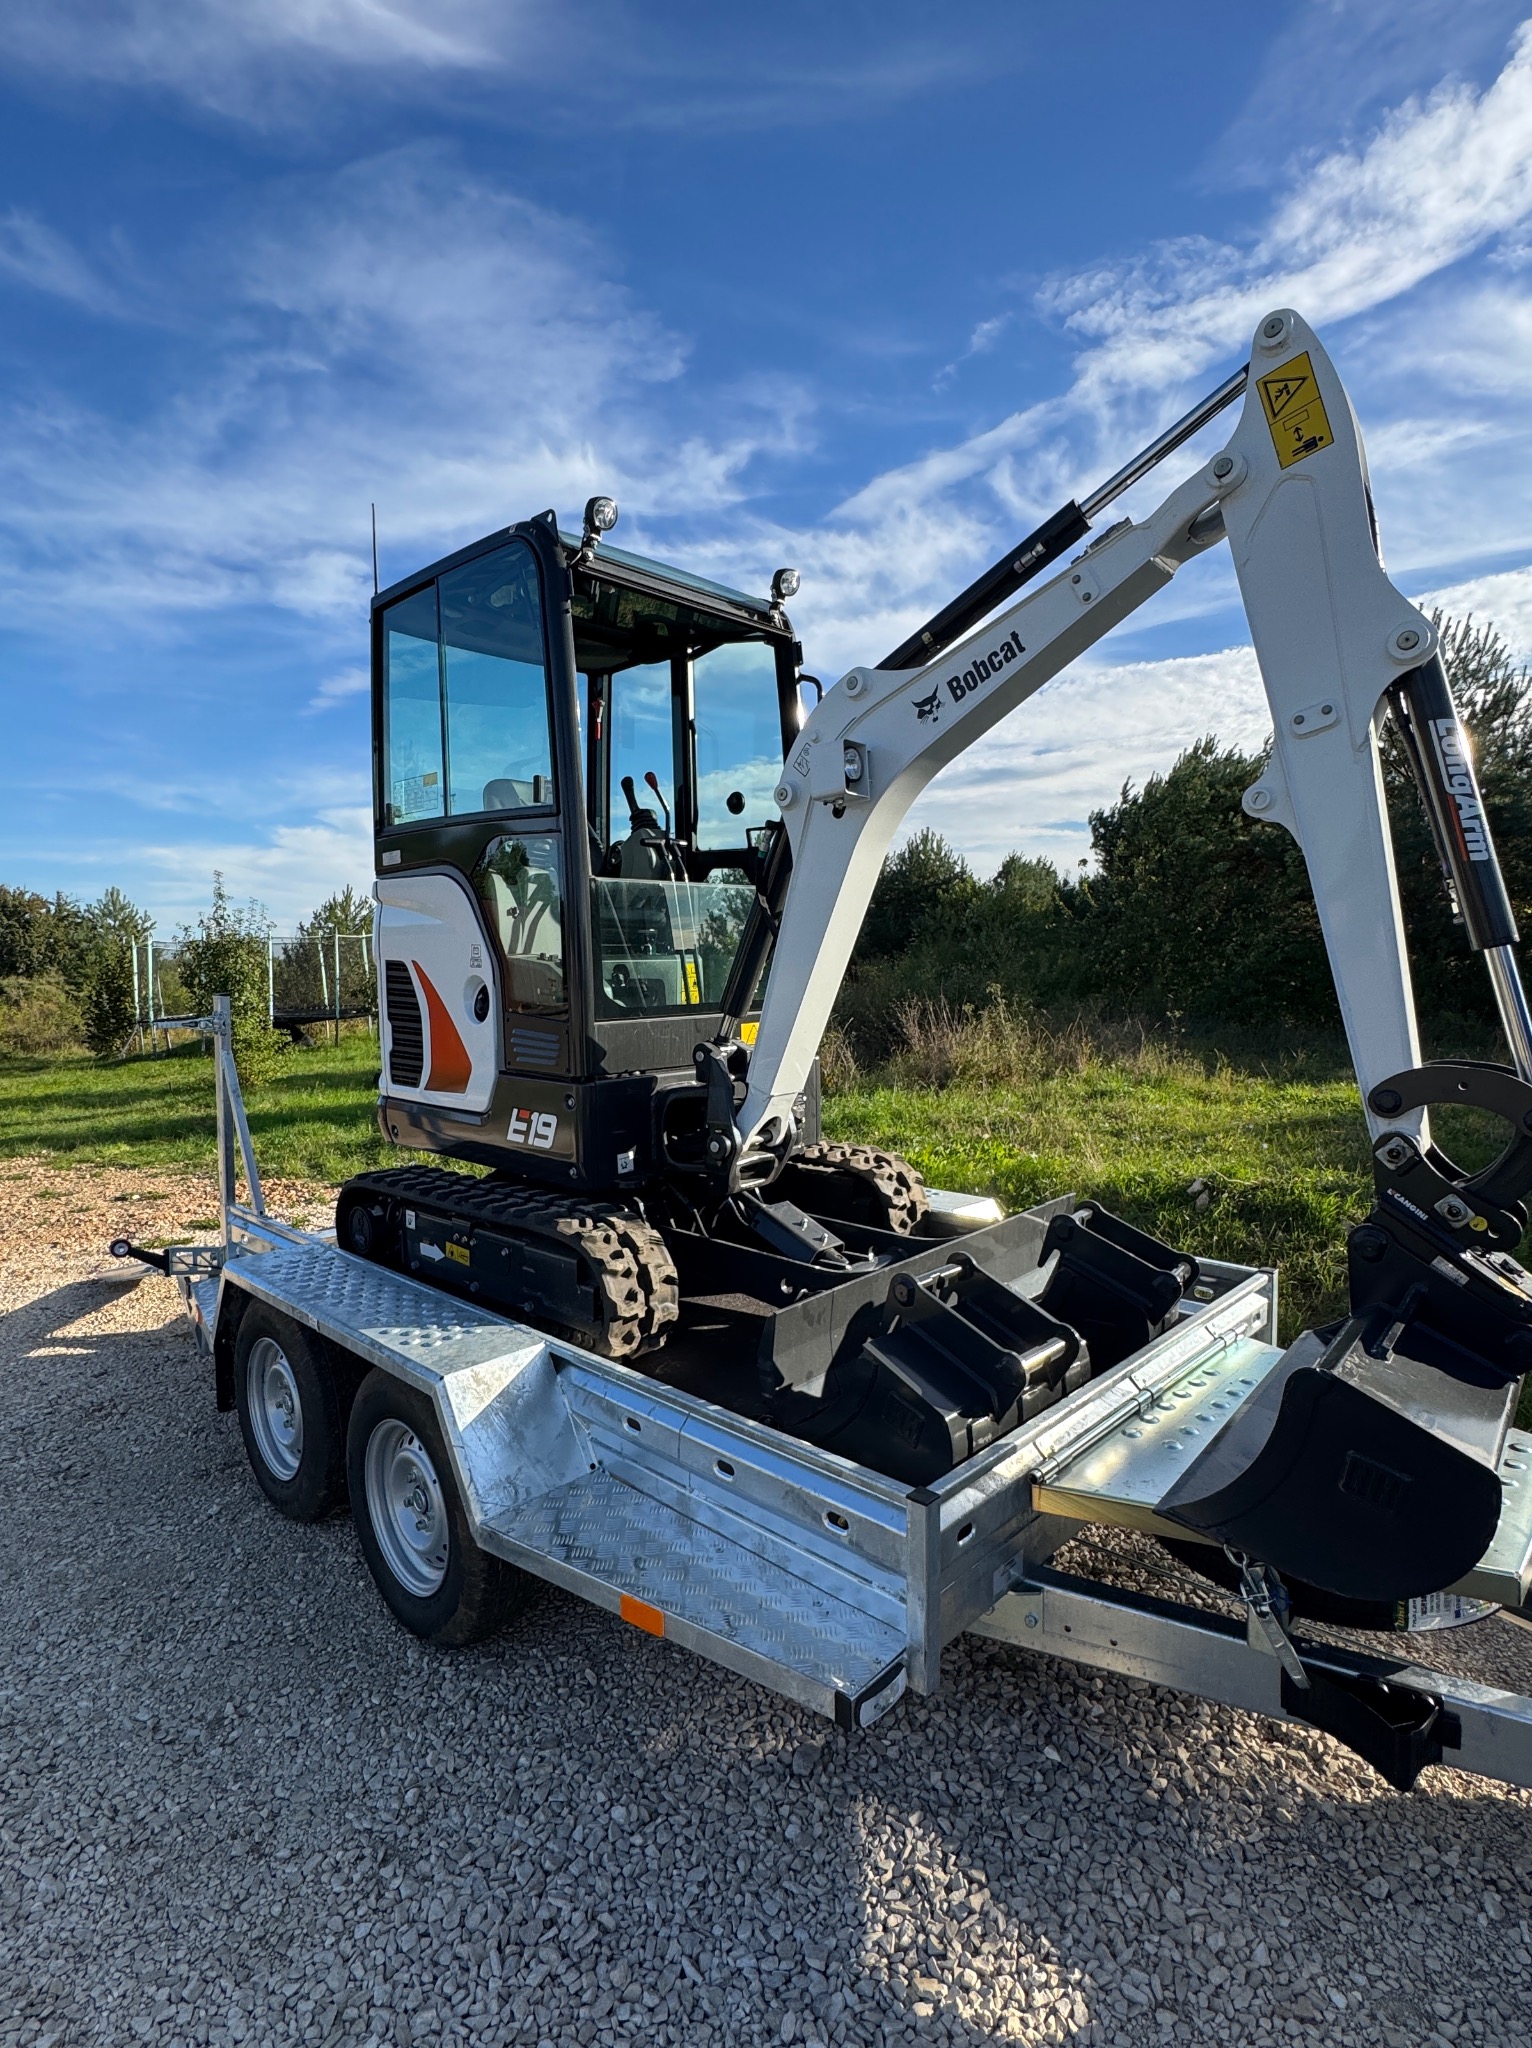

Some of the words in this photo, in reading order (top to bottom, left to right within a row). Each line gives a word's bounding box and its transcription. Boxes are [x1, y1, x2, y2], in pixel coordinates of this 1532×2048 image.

[946, 630, 1026, 703] Bobcat
[507, 1108, 558, 1149] E19
[1393, 1193, 1429, 1220] CANGINI
